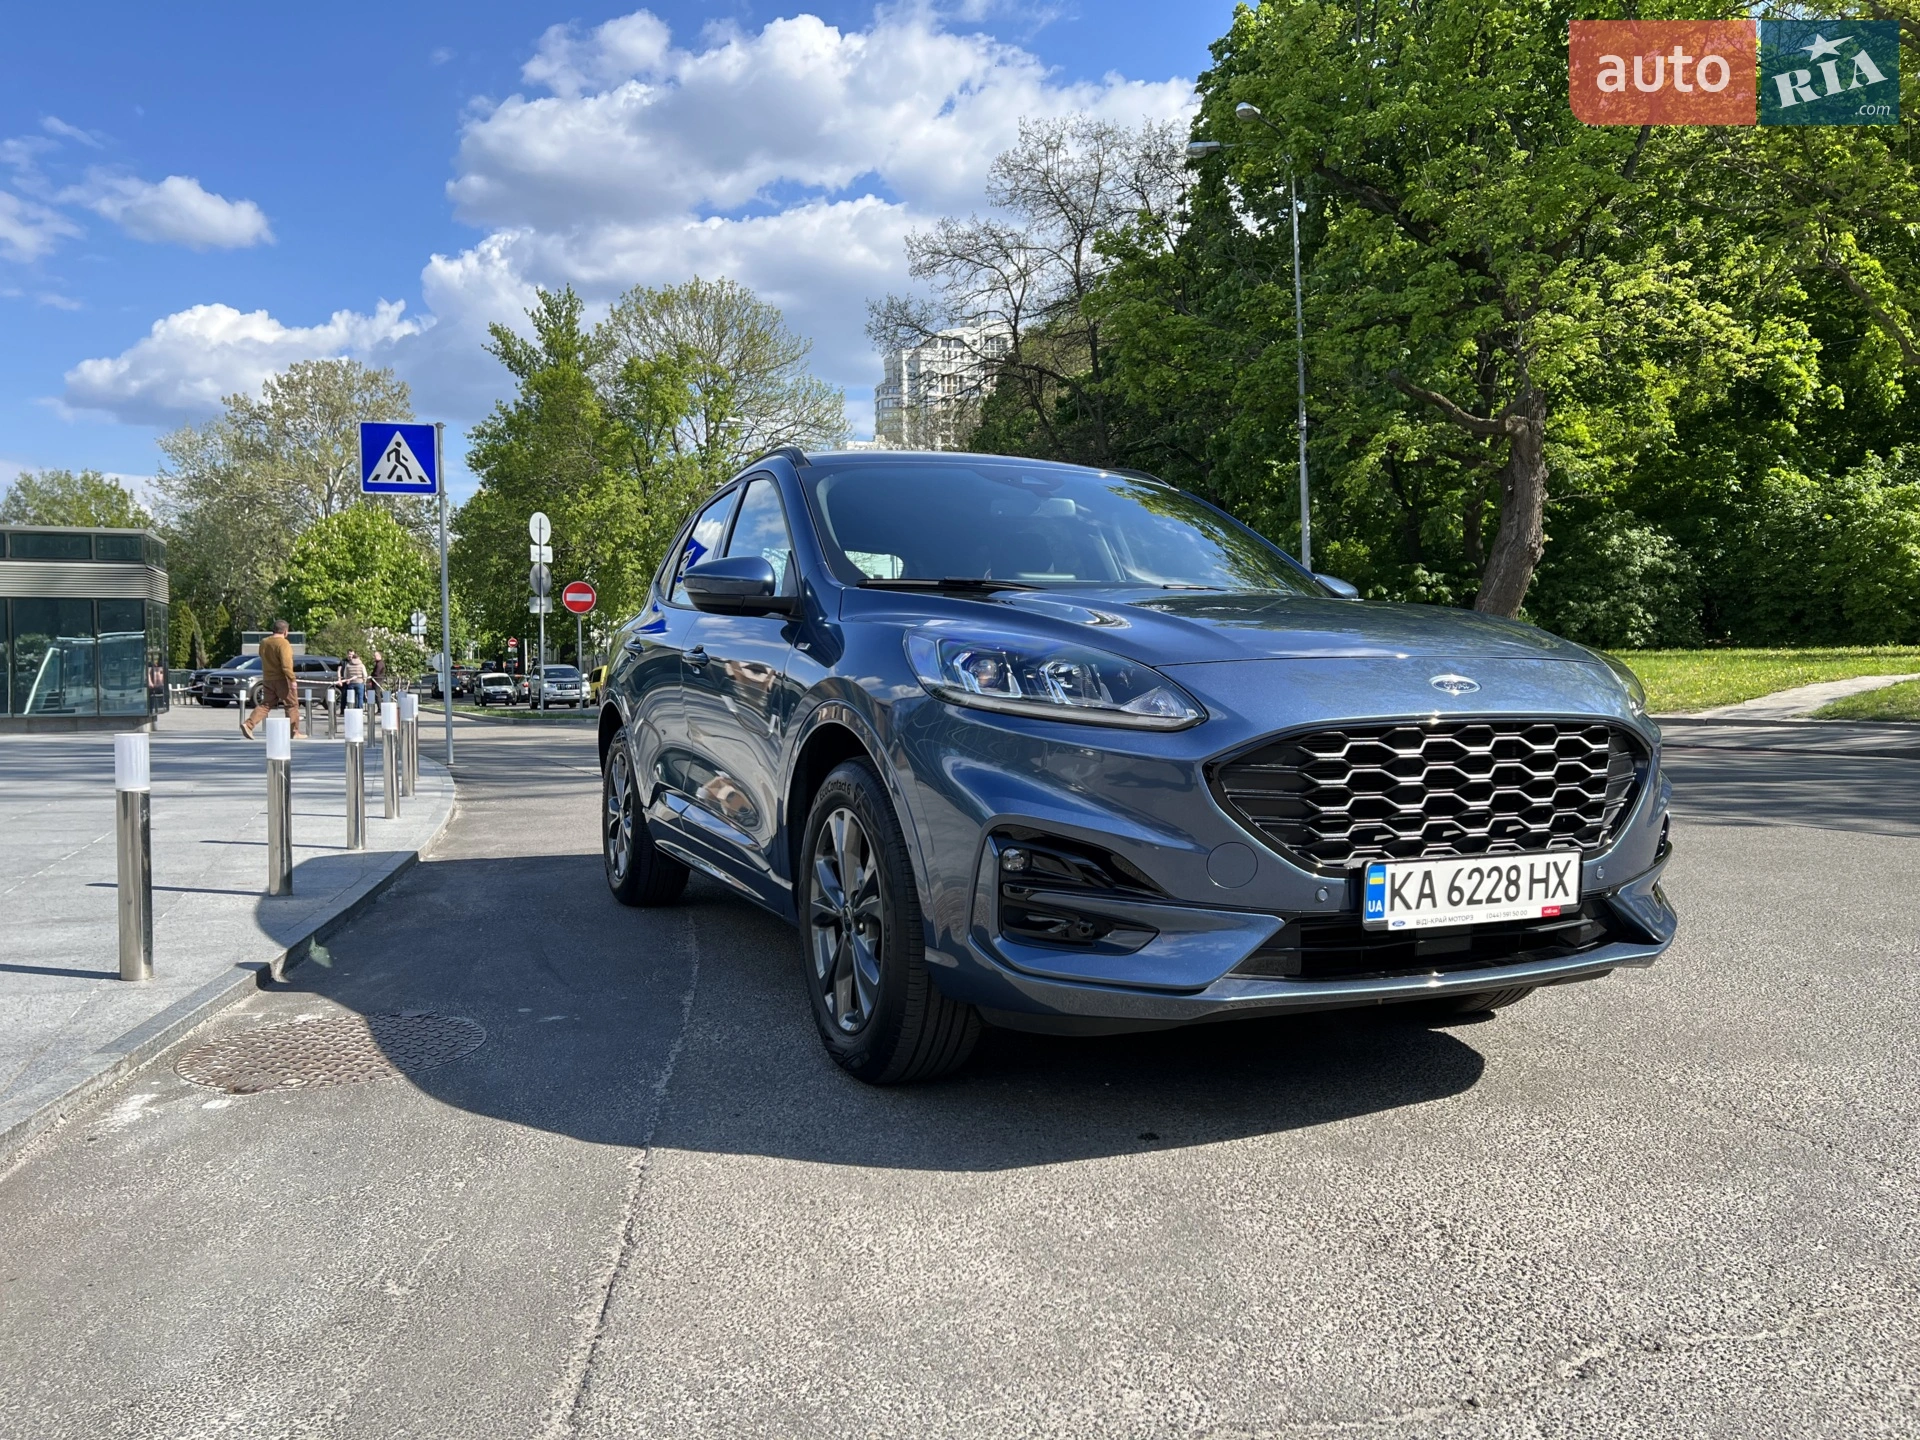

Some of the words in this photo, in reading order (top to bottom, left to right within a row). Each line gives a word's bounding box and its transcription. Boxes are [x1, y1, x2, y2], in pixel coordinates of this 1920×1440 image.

[1389, 870, 1438, 911] KA
[1447, 864, 1522, 907] 6228
[1528, 860, 1572, 900] HX
[1368, 900, 1383, 913] UA
